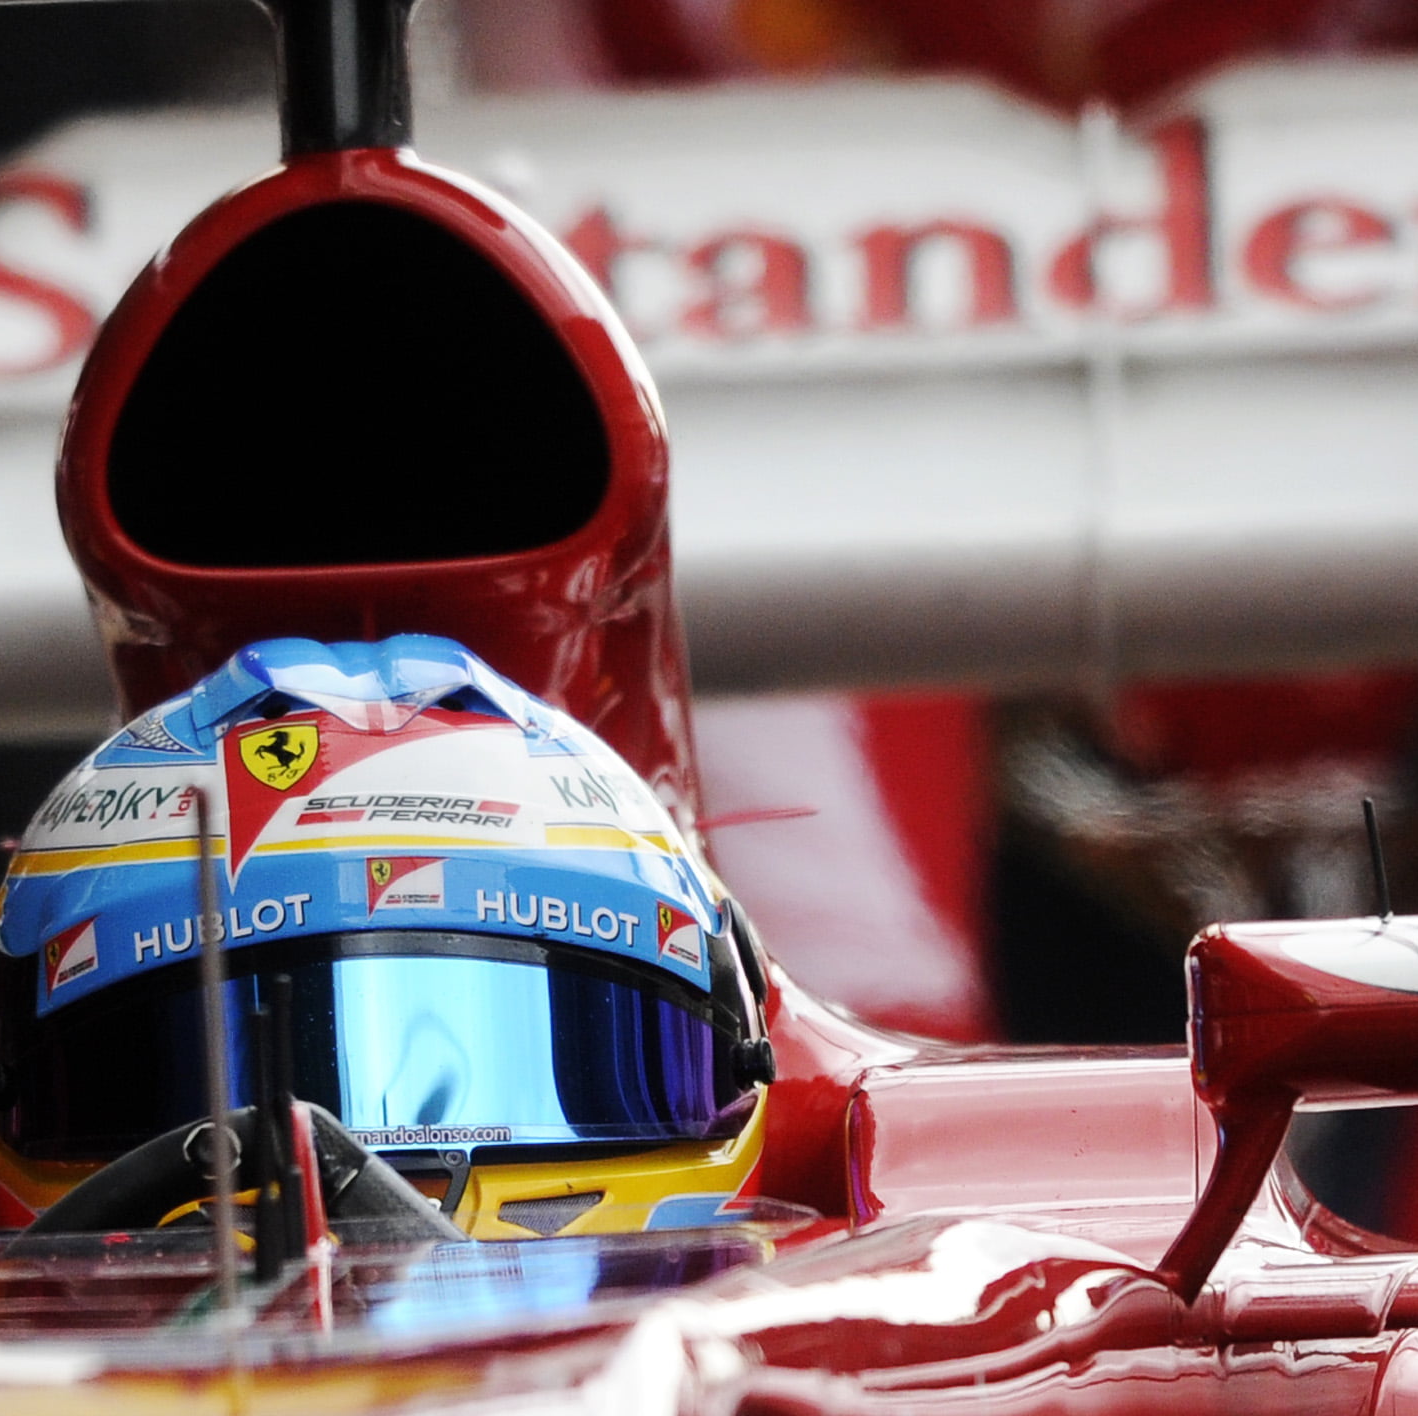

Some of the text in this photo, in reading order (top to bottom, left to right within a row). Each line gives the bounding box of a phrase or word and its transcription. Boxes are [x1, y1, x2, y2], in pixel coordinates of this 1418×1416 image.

[303, 794, 475, 811] SCUDERIA
[366, 810, 513, 829] FERRARI
[133, 893, 312, 964] HUBLOT
[476, 888, 641, 948] HUBLOT
